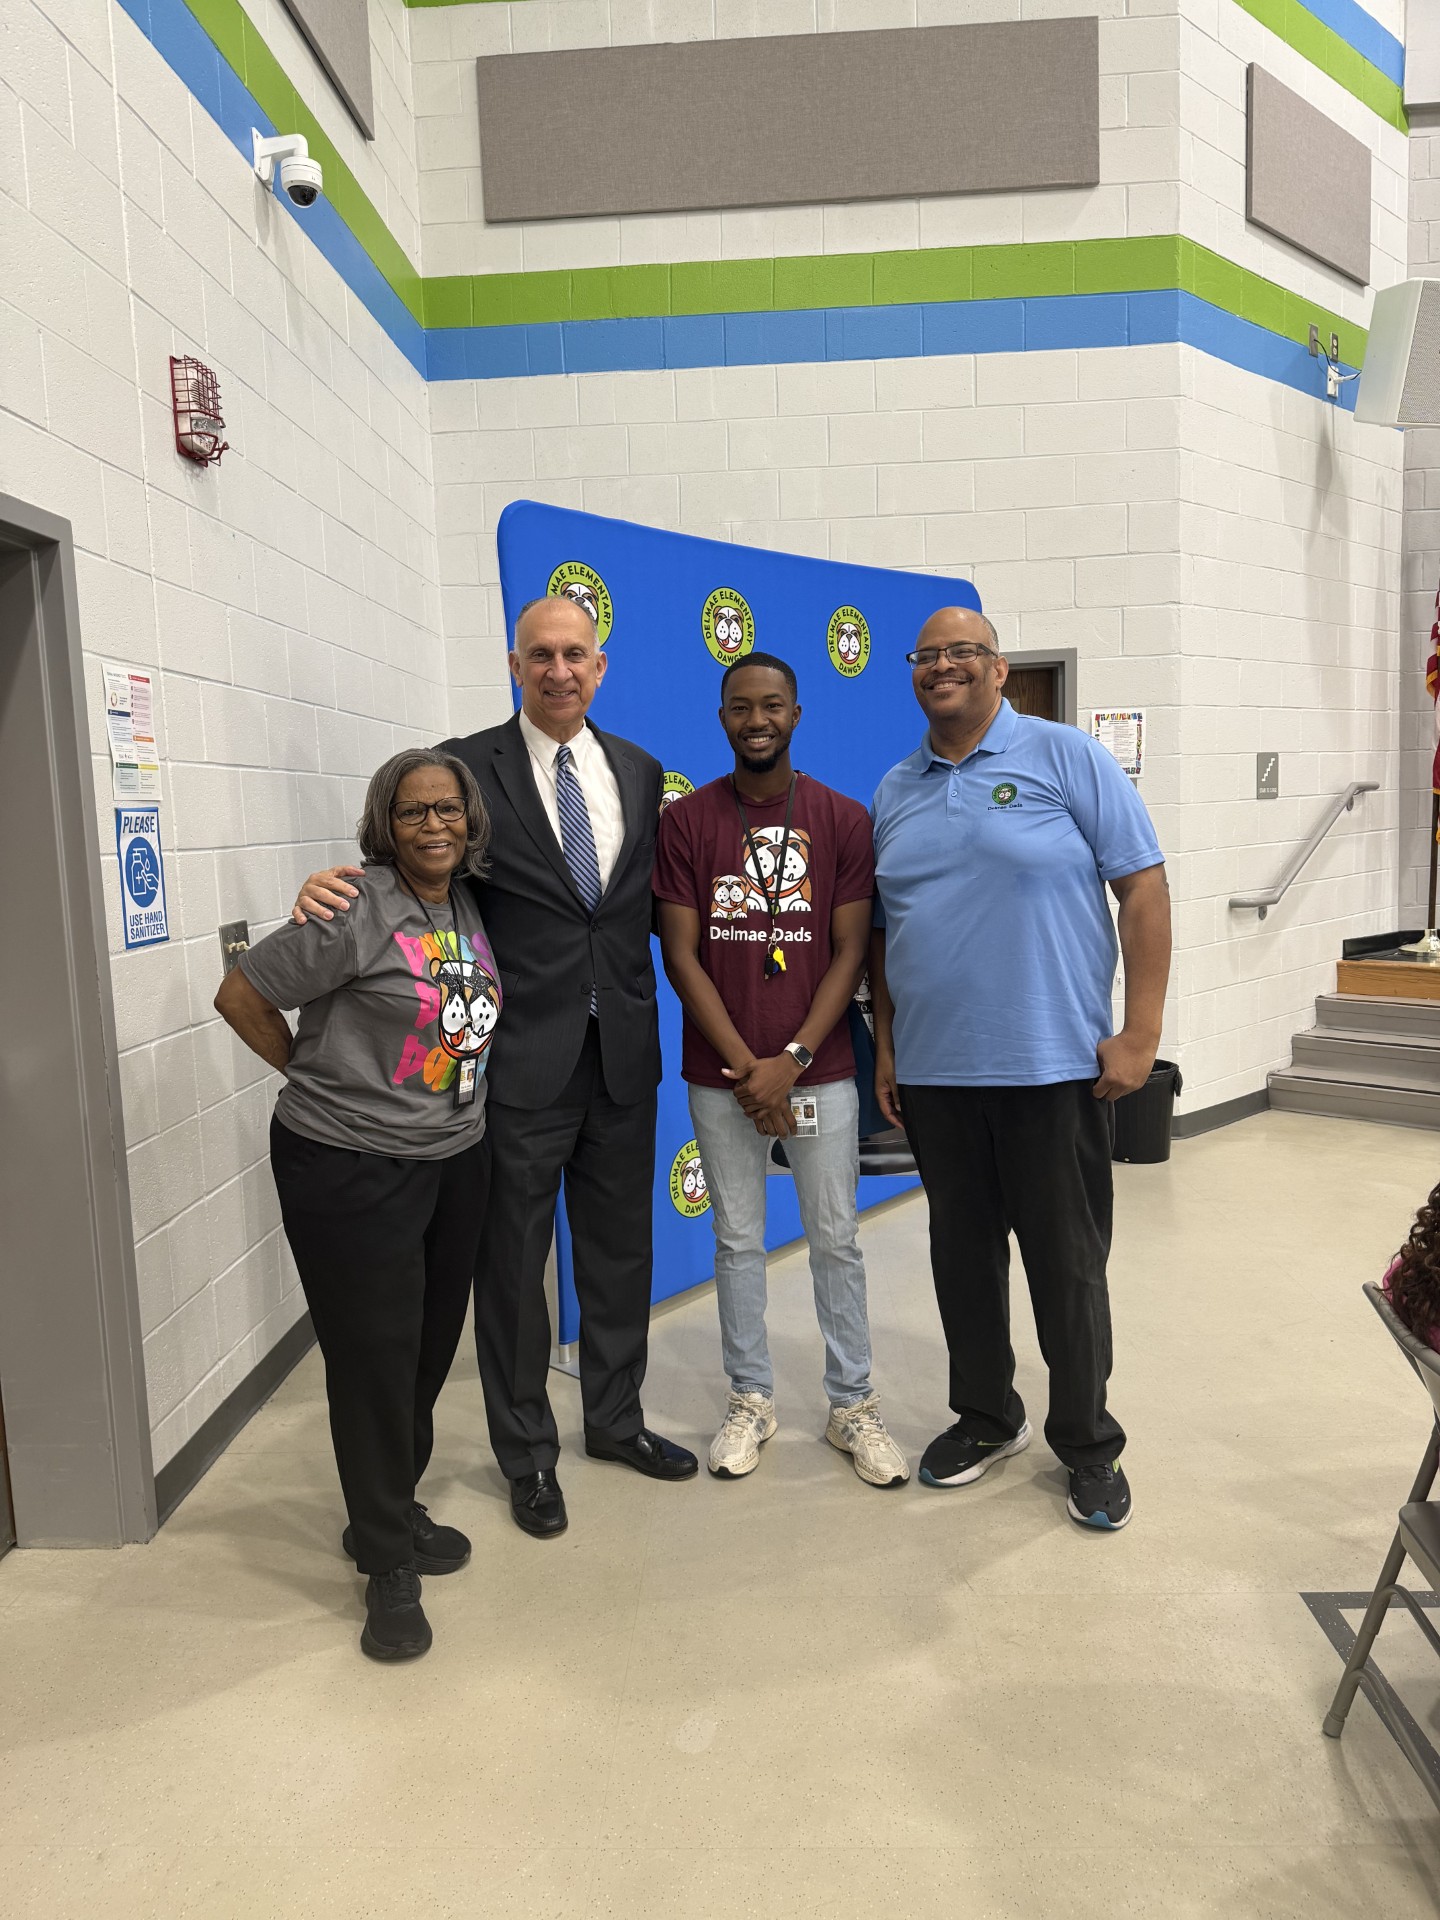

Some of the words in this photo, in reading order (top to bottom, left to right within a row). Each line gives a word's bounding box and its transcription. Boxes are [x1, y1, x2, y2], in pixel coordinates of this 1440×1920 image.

[550, 569, 566, 594] MAE
[567, 565, 611, 628] ELEMENTARY
[703, 594, 719, 639] DELMAE
[719, 590, 754, 645] ELEMENTARY
[829, 613, 841, 653] DELMAE
[842, 608, 869, 656] ELEMENTARY
[838, 662, 861, 674] DAWGS
[122, 816, 155, 833] PLEASE
[130, 913, 143, 926] USE
[145, 911, 163, 925] HAND
[130, 923, 166, 940] SANITIZER
[709, 925, 767, 942] Delmae
[770, 927, 812, 942] Dads
[672, 1152, 685, 1200] DELMAE
